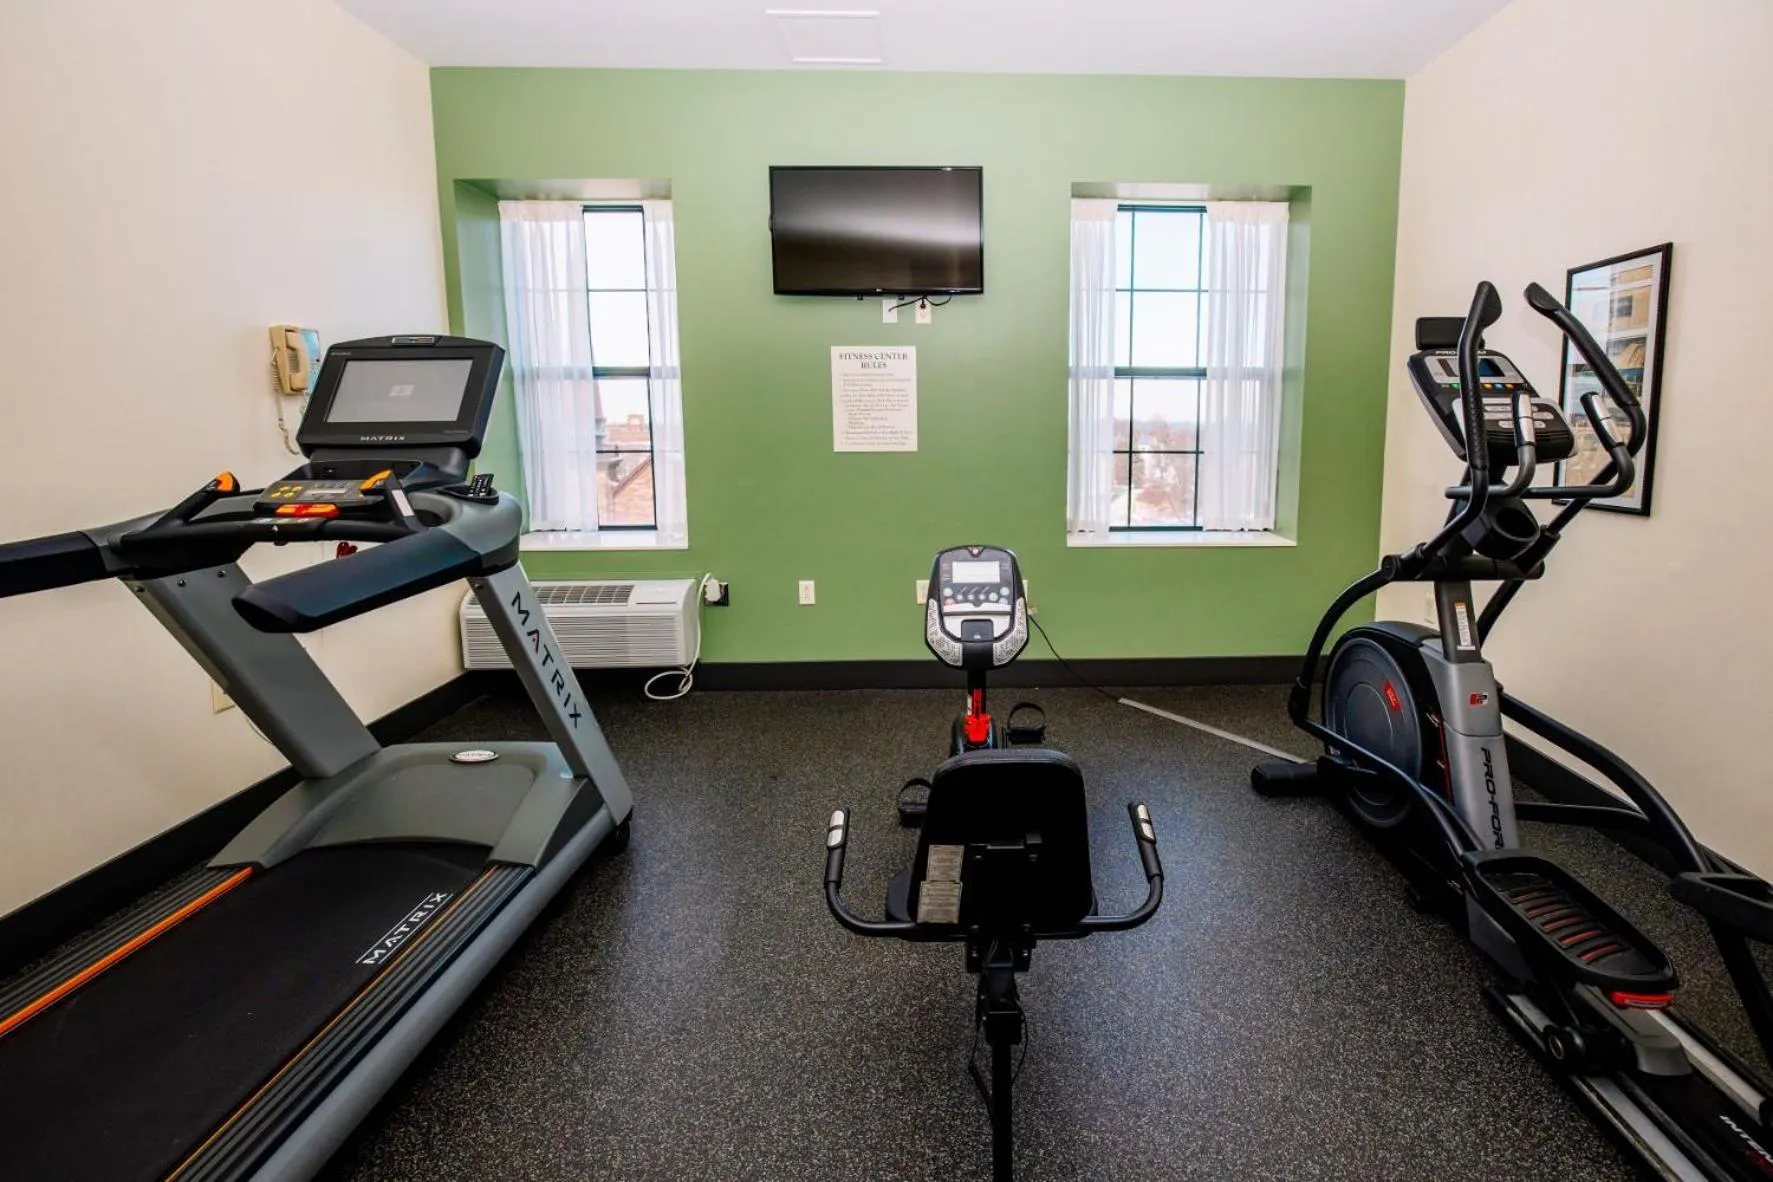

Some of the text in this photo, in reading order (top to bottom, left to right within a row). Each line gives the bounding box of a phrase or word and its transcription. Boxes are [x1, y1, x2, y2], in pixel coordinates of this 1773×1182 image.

[839, 352, 908, 360] FITNESS CENTER
[511, 590, 582, 728] MATRIX
[362, 892, 447, 964] MATRIX
